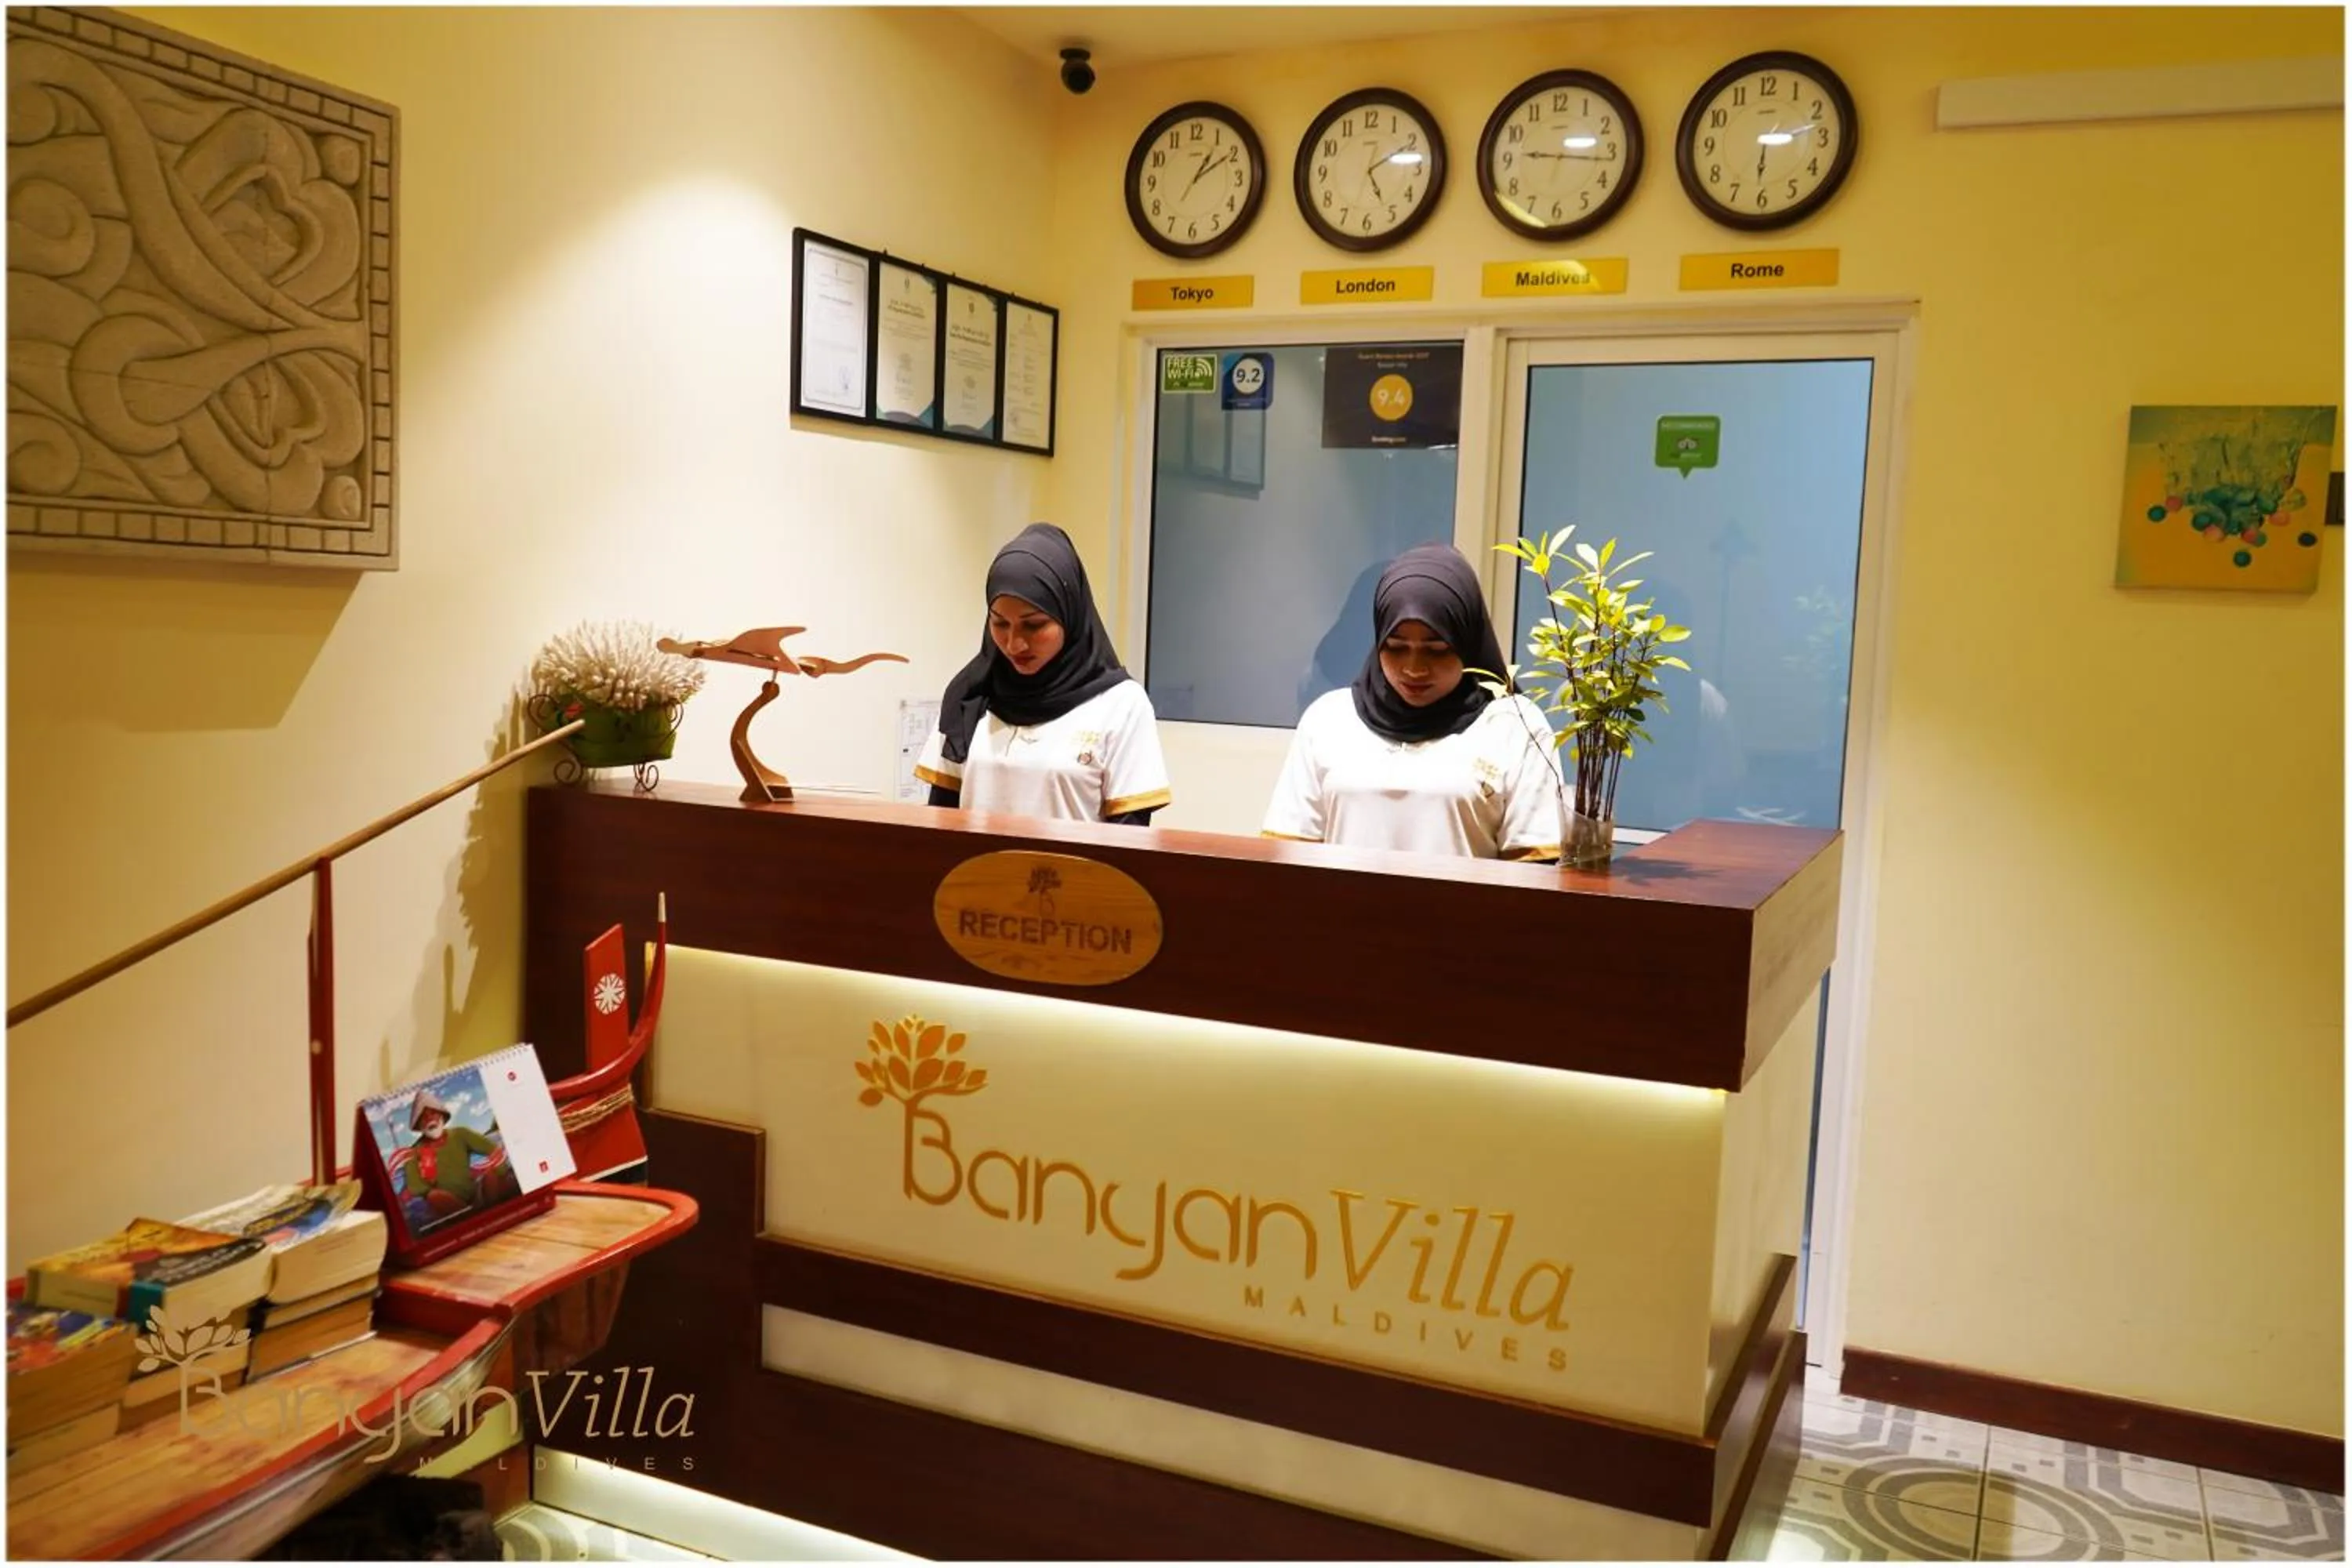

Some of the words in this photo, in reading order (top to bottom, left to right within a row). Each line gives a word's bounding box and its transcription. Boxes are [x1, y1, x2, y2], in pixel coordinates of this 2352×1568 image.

[1759, 76, 1777, 96] 12
[1793, 81, 1798, 101] 1
[1553, 93, 1568, 112] 12
[1733, 86, 1746, 106] 11
[1529, 103, 1539, 122] 11
[1583, 98, 1588, 116] 1
[1811, 100, 1822, 119] 2
[1365, 111, 1378, 129] 12
[1392, 115, 1396, 133] 1
[1600, 116, 1610, 135] 2
[1711, 109, 1727, 128] 10
[1190, 124, 1203, 140] 12
[1342, 119, 1352, 137] 11
[1508, 125, 1523, 143] 10
[1170, 131, 1179, 149] 11
[1215, 129, 1220, 146] 1
[1407, 133, 1417, 151] 2
[1704, 137, 1715, 156] 9
[1818, 127, 1829, 148] 3
[1230, 146, 1238, 163] 2
[1324, 140, 1338, 157] 10
[1607, 143, 1617, 161] 3
[1152, 151, 1165, 168] 10
[1503, 152, 1512, 170] 9
[1807, 158, 1818, 176] 4
[1235, 170, 1243, 187] 3
[1318, 165, 1327, 183] 9
[1597, 170, 1606, 188] 4
[1710, 165, 1721, 183] 8
[1148, 175, 1156, 192] 9
[1508, 177, 1518, 196] 8
[1730, 183, 1740, 202] 7
[1786, 179, 1798, 199] 5
[1323, 191, 1332, 208] 8
[1404, 185, 1413, 202] 4
[1580, 191, 1589, 210] 5
[1756, 189, 1767, 207] 6
[1152, 199, 1160, 216] 8
[1226, 194, 1235, 212] 4
[1527, 196, 1537, 213] 7
[1552, 201, 1562, 219] 6
[1211, 214, 1220, 231] 5
[1340, 208, 1348, 226] 7
[1362, 213, 1371, 230] 6
[1388, 205, 1397, 223] 5
[1167, 216, 1175, 233] 7
[1188, 222, 1196, 239] 6
[1515, 272, 1591, 286] Maldives
[1730, 263, 1784, 279] Rome
[1171, 286, 1214, 301] Tokyo
[1336, 278, 1396, 294] London
[1167, 357, 1194, 367] FREE
[1236, 368, 1261, 383] 9.2
[1377, 389, 1406, 406] 9.4
[959, 909, 1132, 954] RECEPTION
[902, 1101, 1319, 1281] Banyan
[1328, 1189, 1574, 1333] Villa
[1244, 1285, 1567, 1372] MALDIVES
